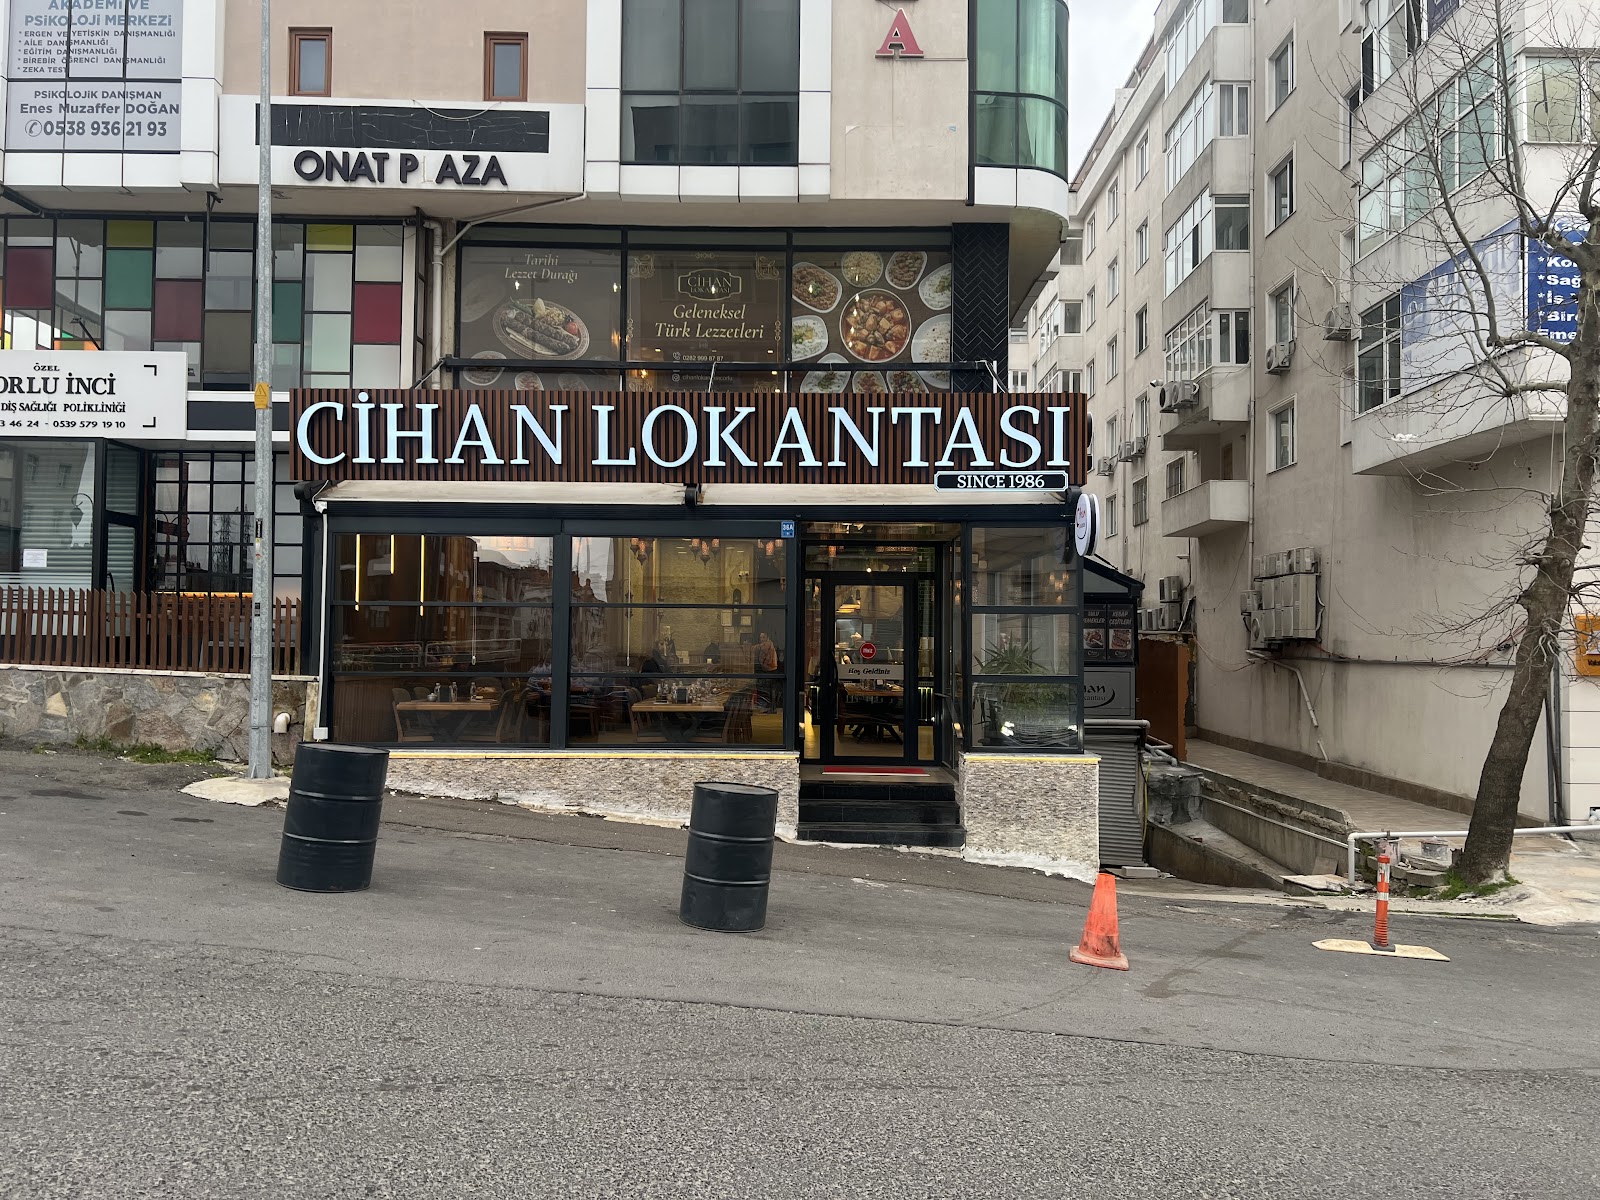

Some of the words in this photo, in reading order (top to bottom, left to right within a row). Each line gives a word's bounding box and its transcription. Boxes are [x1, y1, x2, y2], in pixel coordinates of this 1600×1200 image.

[72, 29, 110, 38] YETİŞKİN
[875, 8, 924, 58] A
[24, 38, 43, 46] AİLE
[23, 47, 52, 55] EĞİTİM
[23, 56, 56, 64] BİREBİR
[101, 90, 162, 101] DANIŞMAN
[20, 103, 53, 114] Enes
[58, 103, 120, 114] Muzaffer
[125, 101, 180, 114] DOĞAN
[43, 120, 86, 136] 0538
[90, 121, 121, 136] 936
[125, 121, 142, 136] 21
[147, 121, 167, 137] 93
[293, 150, 390, 183] ONAT
[524, 253, 559, 266] Tarihi
[504, 268, 538, 280] Lezzet
[541, 269, 578, 283] Durağı
[687, 274, 732, 288] CİHAN
[673, 303, 746, 320] Geleneksel
[655, 322, 690, 338] Türk
[695, 323, 764, 339] Lezzetleri
[33, 362, 60, 371] ÖZEL
[66, 372, 117, 396] İNCİ
[1, 400, 17, 414] DİŞ
[19, 401, 57, 413] SAĞLIĞI
[63, 401, 126, 413] POLİKLİNİĞİ
[9, 420, 22, 428] 46
[27, 420, 39, 428] 24
[53, 420, 76, 429] 0539
[79, 420, 98, 429] 579
[102, 421, 113, 429] 19
[116, 421, 126, 429] 10
[296, 391, 569, 466] CİHAN
[591, 403, 1071, 469] LOKANTASI
[957, 474, 1006, 489] SINCE
[1009, 474, 1045, 489] 1986
